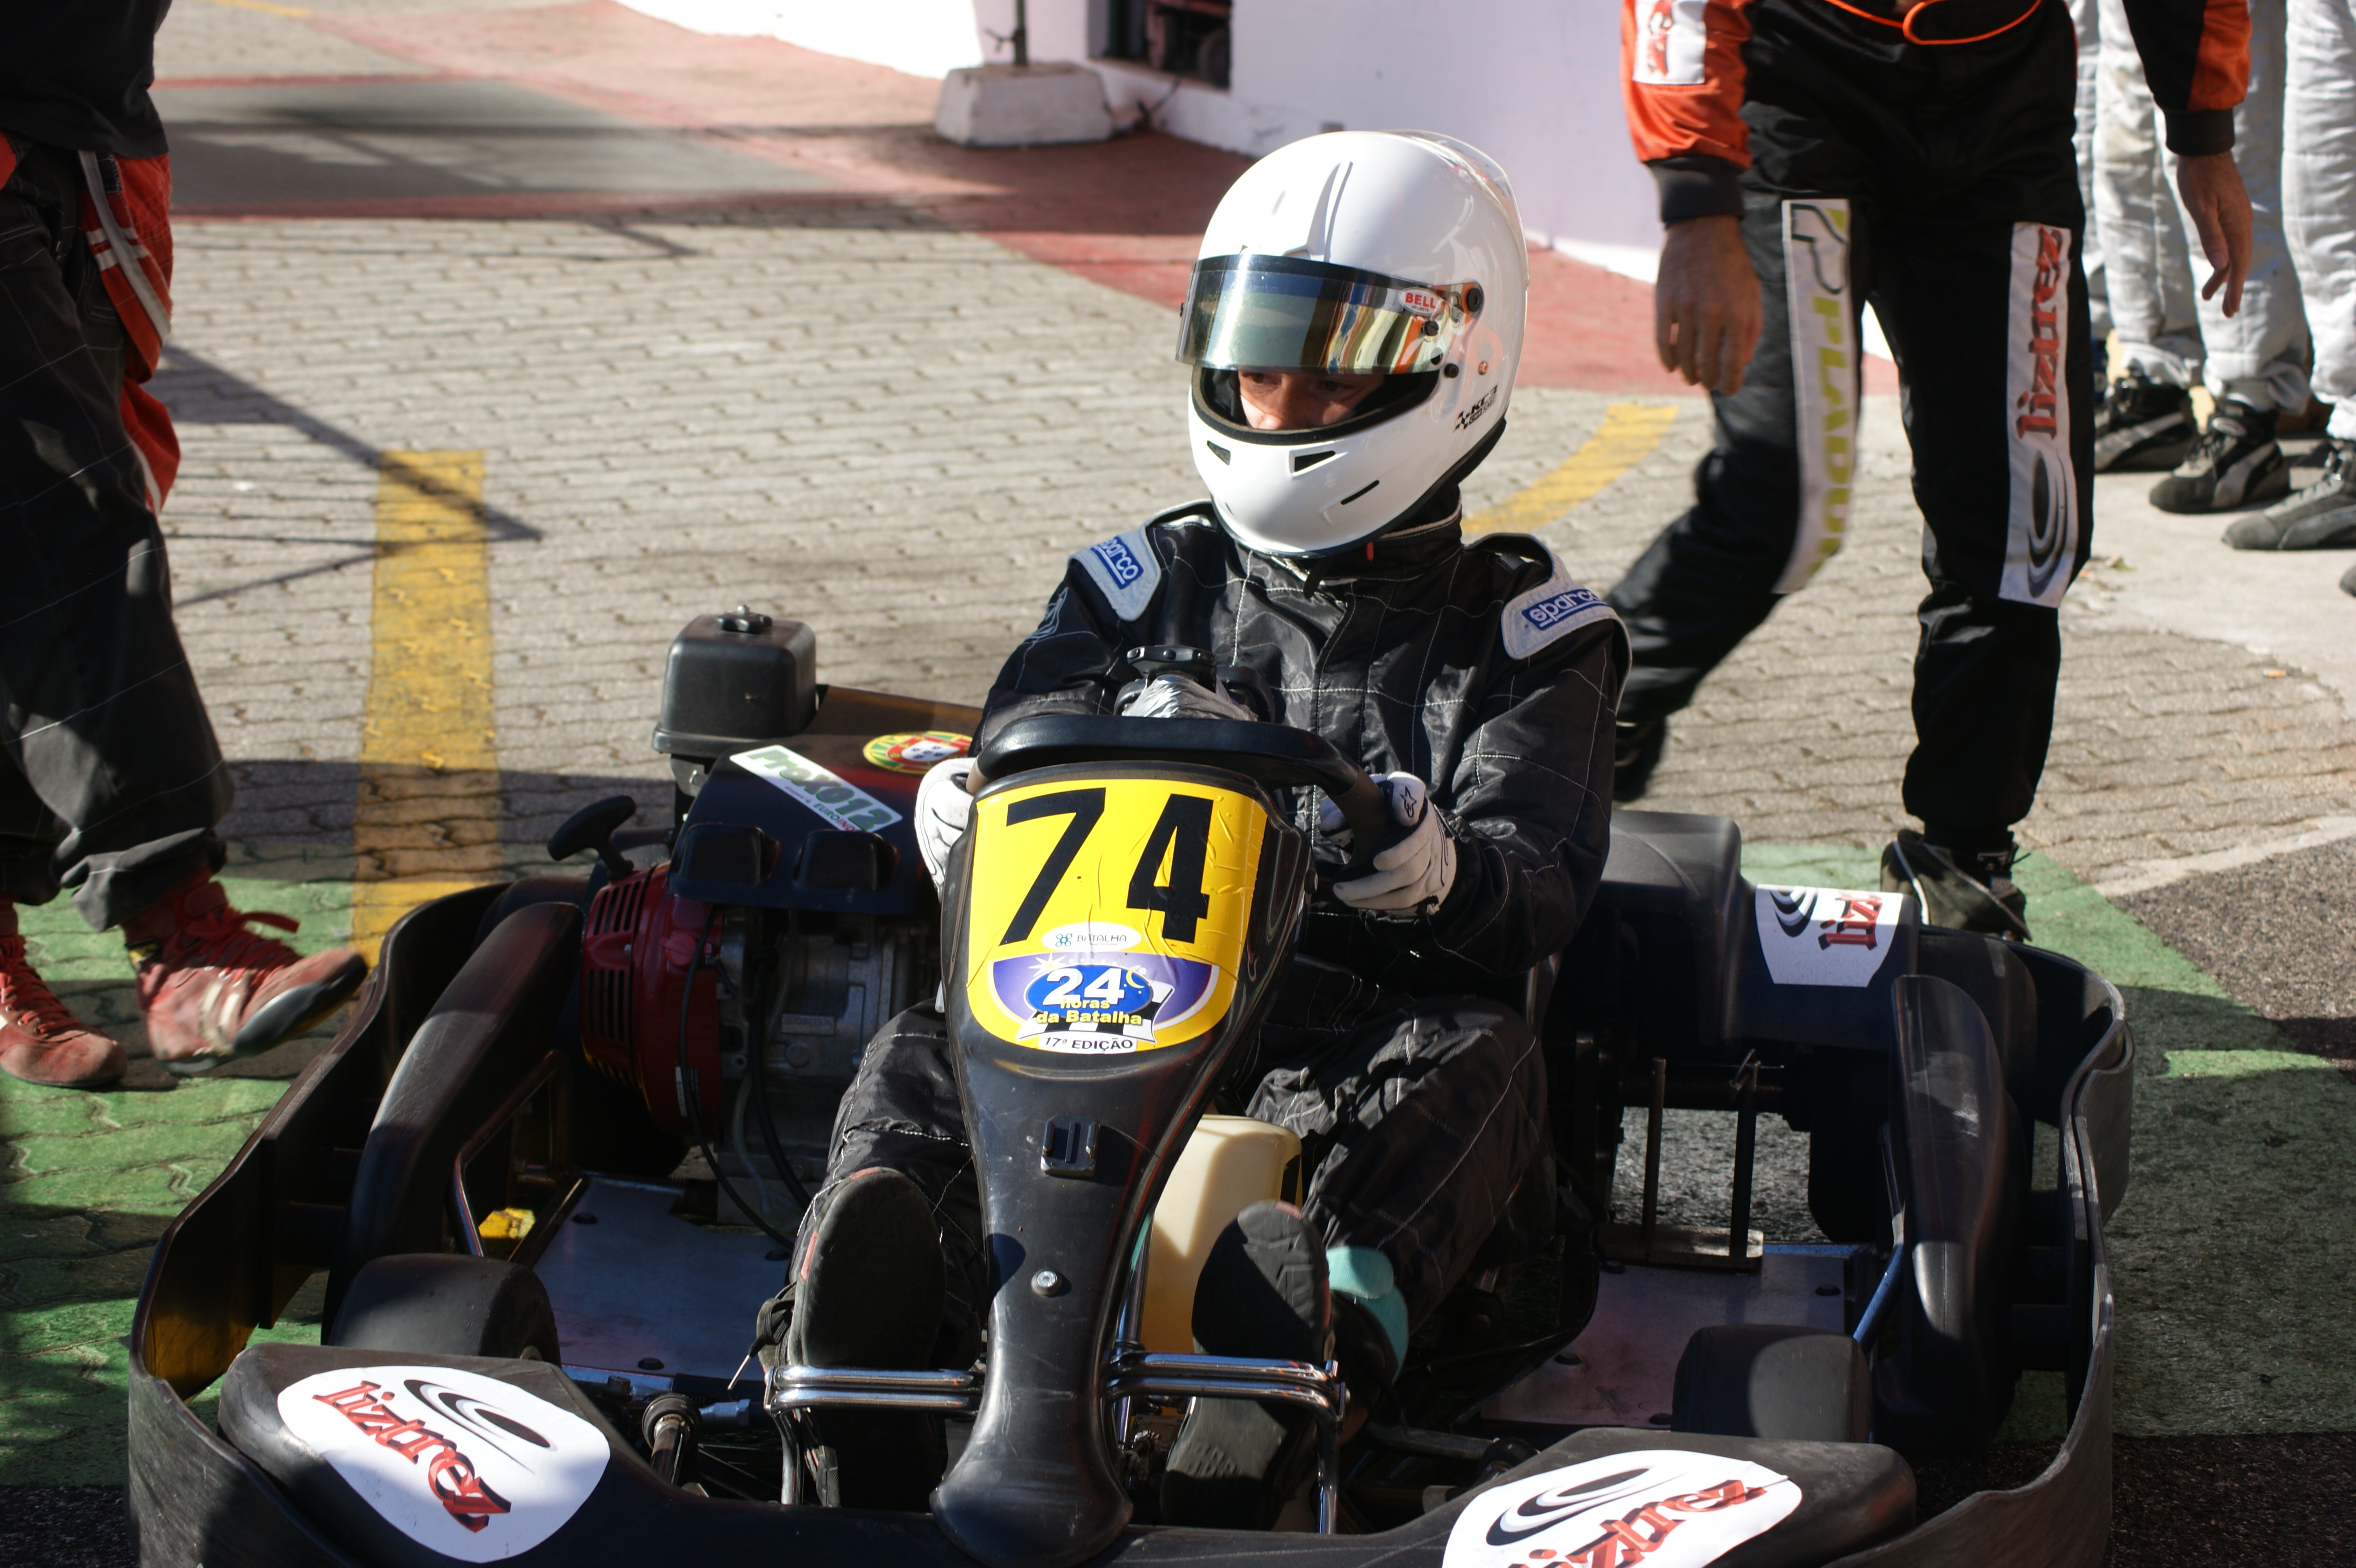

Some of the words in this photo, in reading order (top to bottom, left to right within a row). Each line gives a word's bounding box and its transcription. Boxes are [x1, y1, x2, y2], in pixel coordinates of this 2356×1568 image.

[1405, 292, 1436, 309] BELL
[2015, 227, 2063, 440] liztrez
[1098, 538, 1138, 580] parco
[998, 787, 1214, 946] 74
[1077, 934, 1127, 943] BATALHA
[1043, 968, 1125, 1005] 24
[1060, 998, 1110, 1009] horas
[1036, 1011, 1060, 1023] da
[1066, 1010, 1142, 1025] Batalha
[1071, 1037, 1133, 1052] EDIÇÃO
[312, 1380, 512, 1533] liztrez
[1507, 1480, 1767, 1568] ztrez
